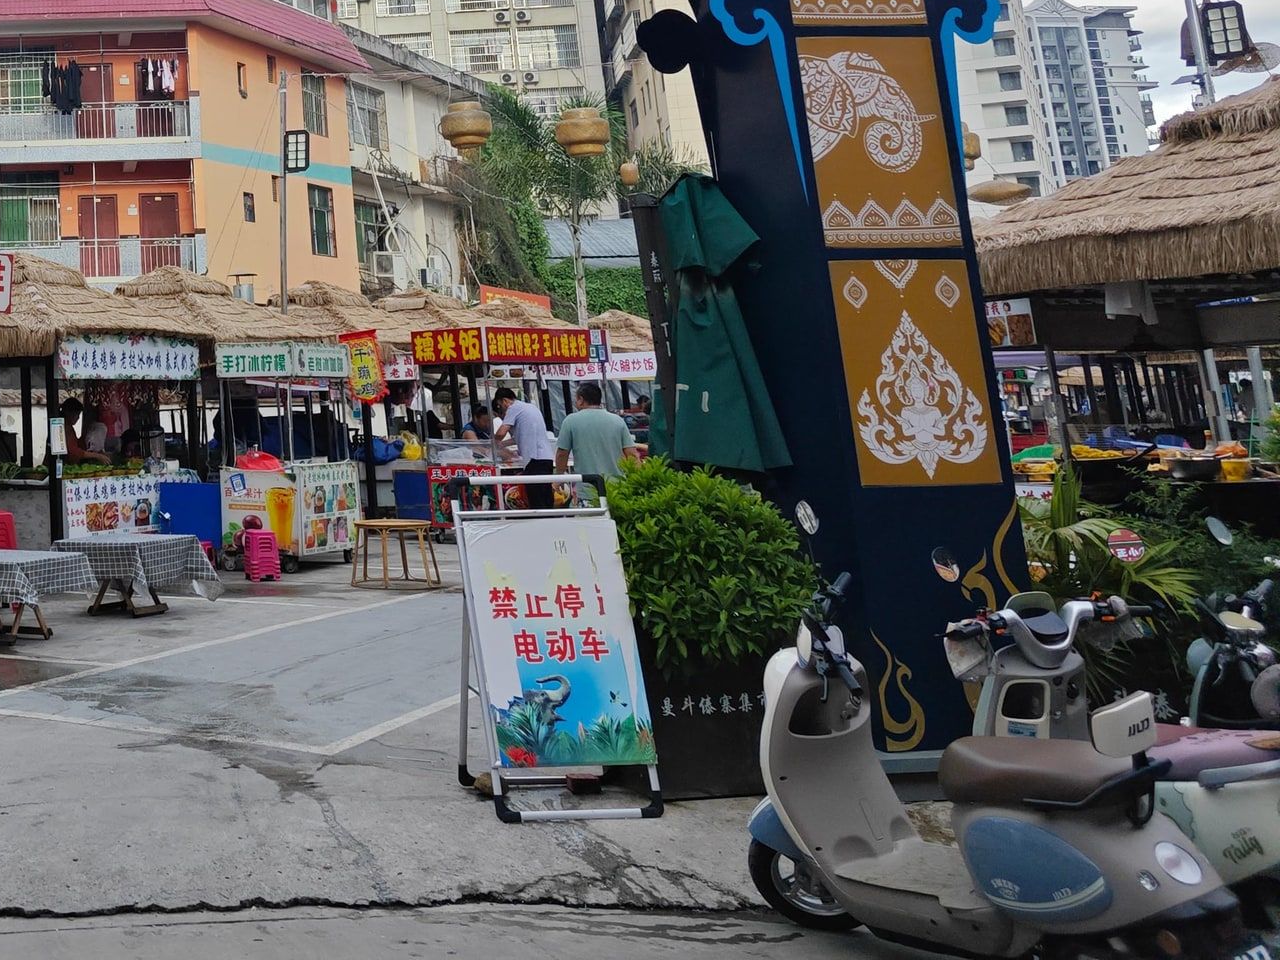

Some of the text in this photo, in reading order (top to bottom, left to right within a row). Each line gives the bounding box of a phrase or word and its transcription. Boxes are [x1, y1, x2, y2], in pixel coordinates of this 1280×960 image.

[414, 329, 481, 363] 糯米饭
[222, 354, 286, 373] 手打冰柠檬
[224, 486, 262, 499] 百果汁
[489, 583, 606, 620] 禁止停
[513, 626, 610, 663] 电动车
